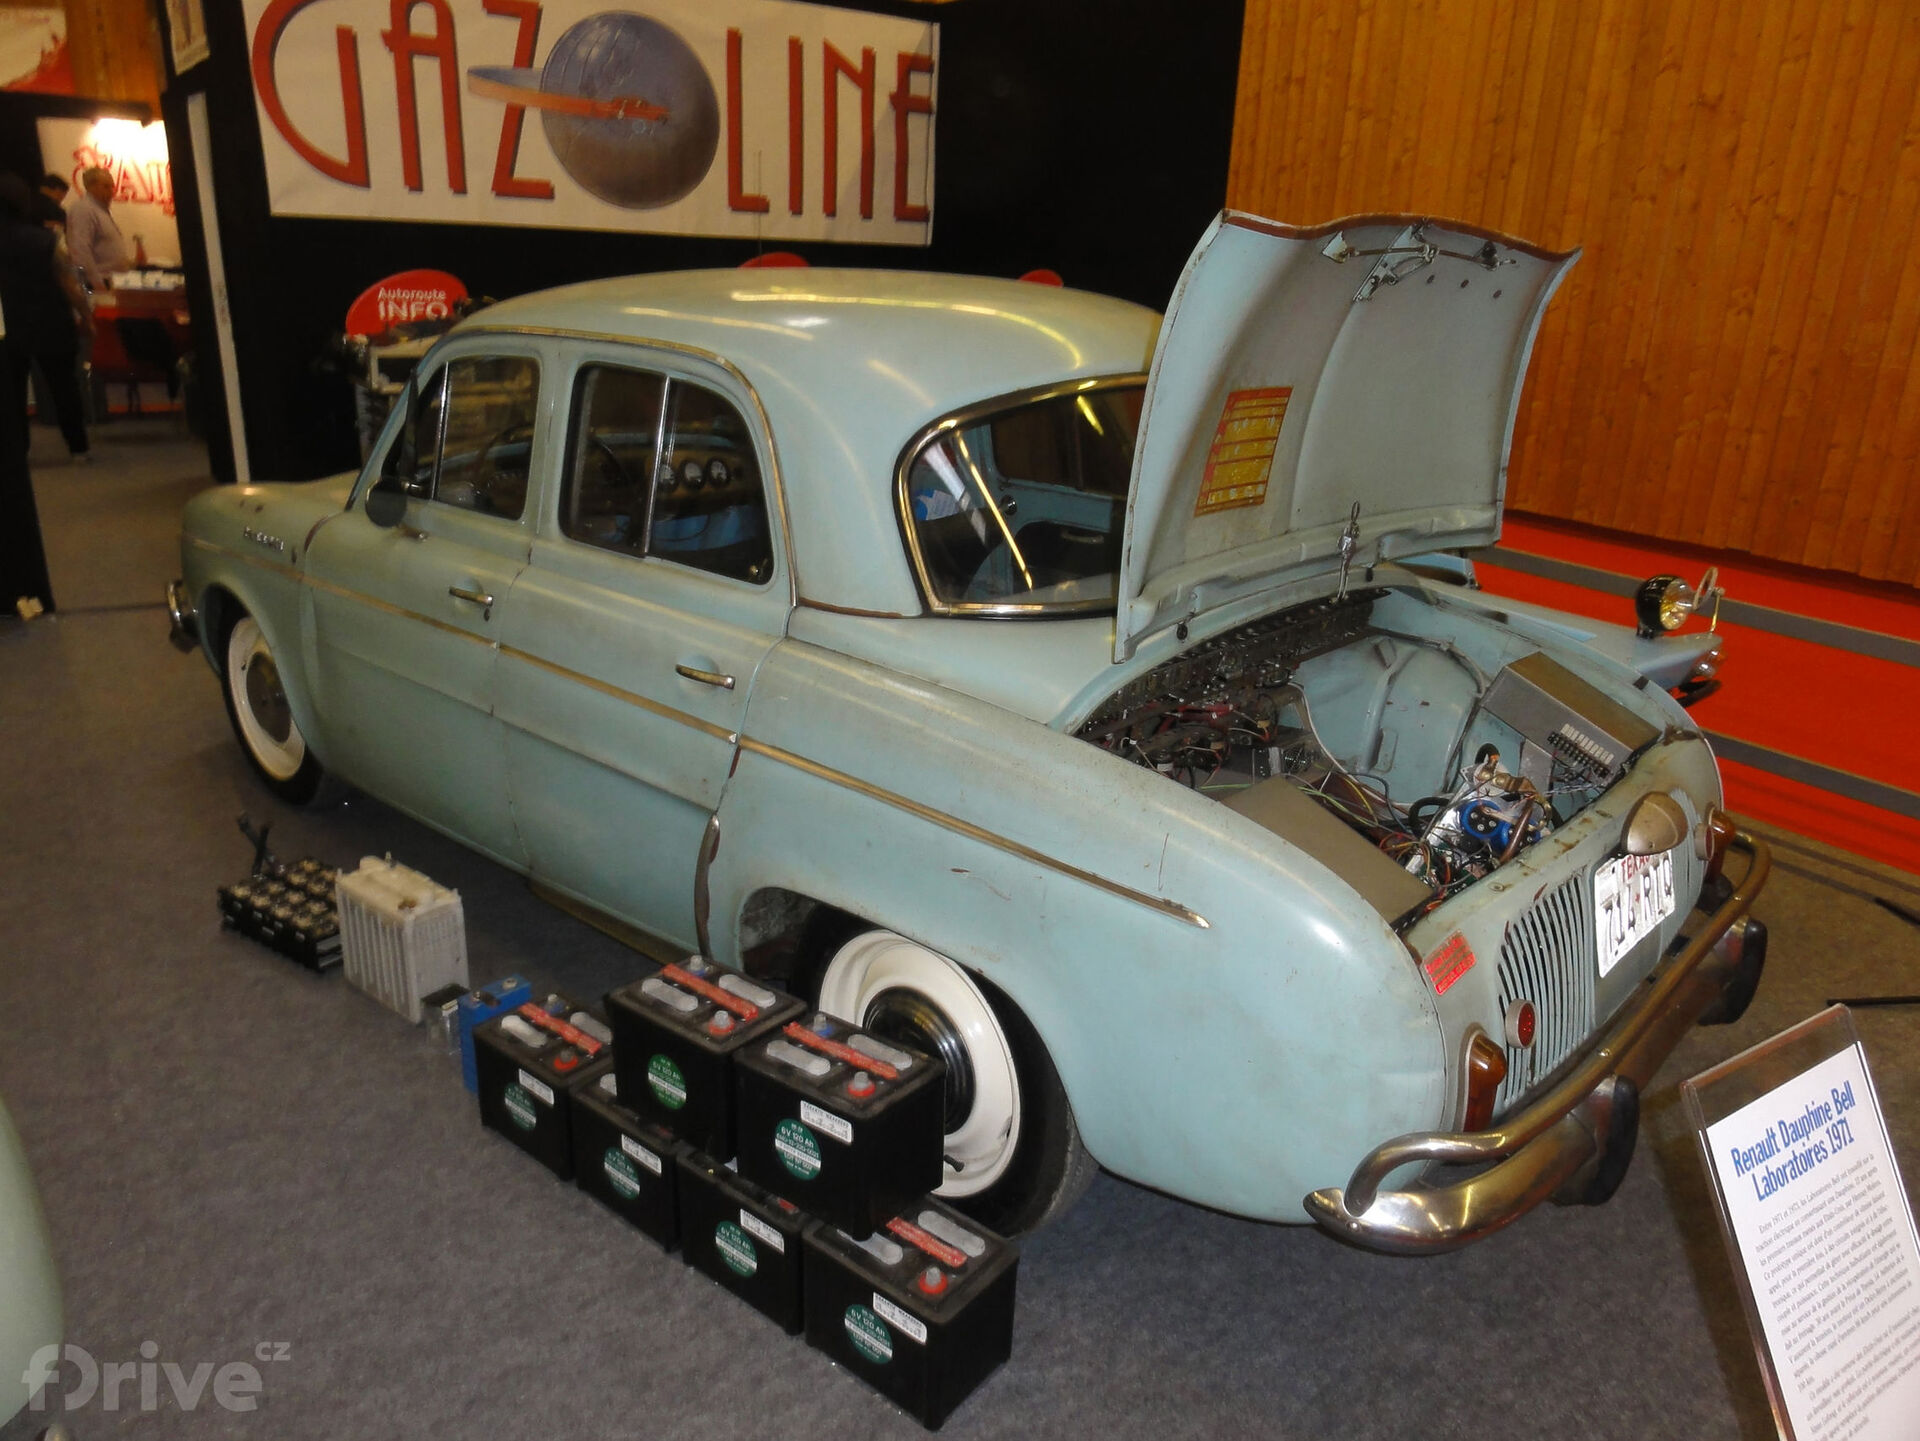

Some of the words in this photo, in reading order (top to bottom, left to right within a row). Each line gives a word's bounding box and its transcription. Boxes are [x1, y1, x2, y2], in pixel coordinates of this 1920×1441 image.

[378, 287, 446, 300] Autoroute
[379, 301, 448, 321] INFO
[1731, 1127, 1779, 1178] Renault
[1779, 1100, 1834, 1148] Dauphine
[1831, 1080, 1856, 1117] Bell
[1752, 1140, 1829, 1202] Laboratoires
[1826, 1118, 1855, 1156] 1971
